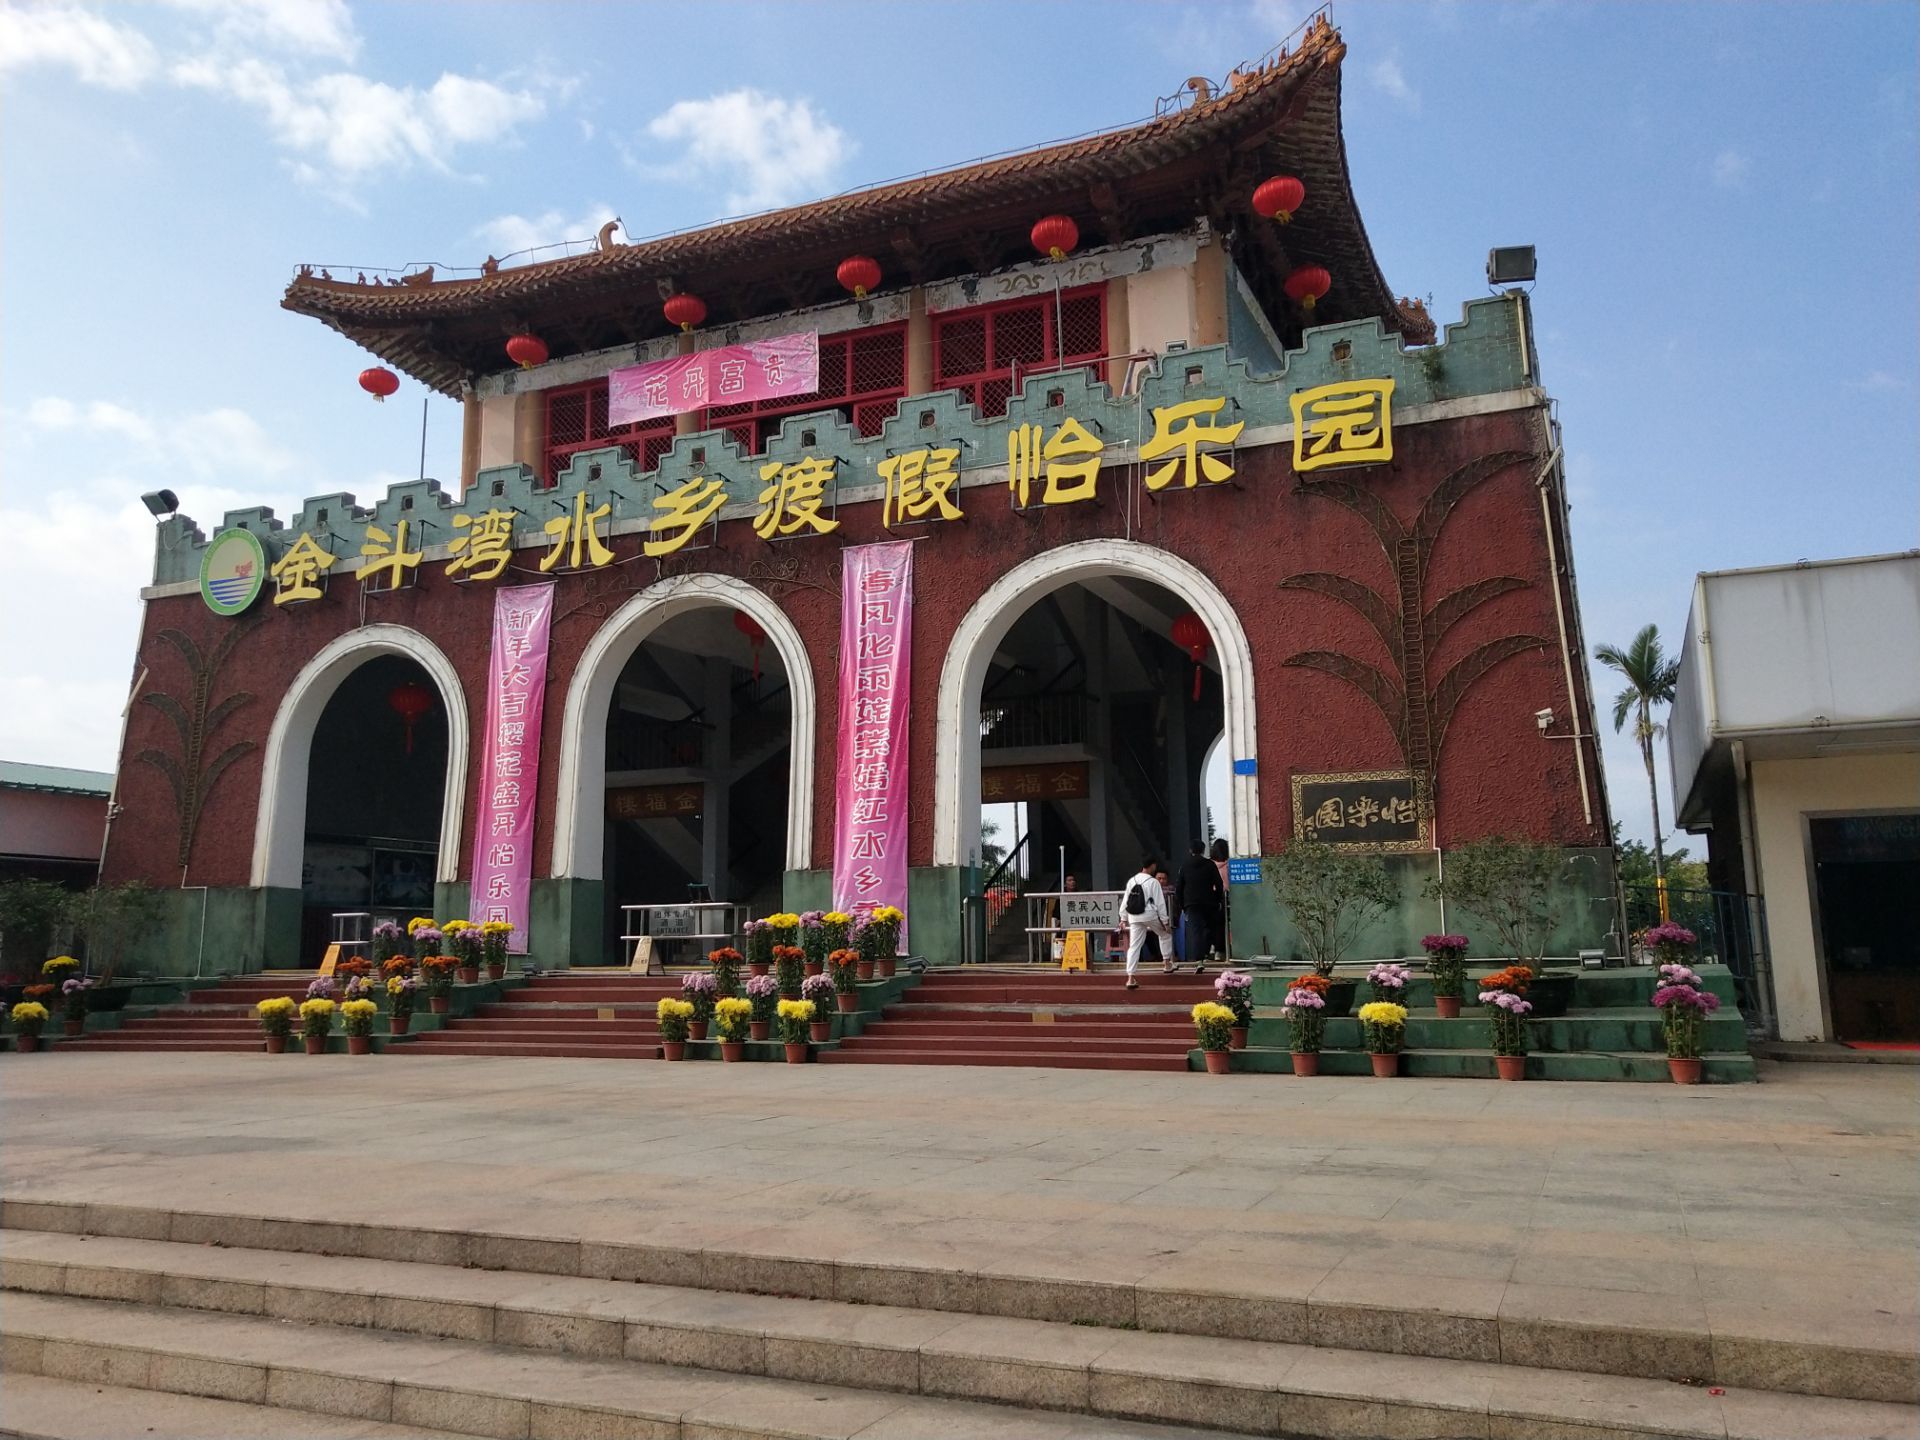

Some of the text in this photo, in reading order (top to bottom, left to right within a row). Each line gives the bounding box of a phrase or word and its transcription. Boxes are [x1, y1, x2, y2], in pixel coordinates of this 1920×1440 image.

[643, 353, 786, 408] 花开富贵
[269, 377, 1396, 605] 金斗湾水乡渡假怡乐园
[487, 607, 537, 923] 新年大吉樱花盛开怡乐园
[1066, 900, 1113, 913] 贵宾入口
[1070, 915, 1111, 925] ENTRANCE
[656, 926, 689, 934] ENTRANCE
